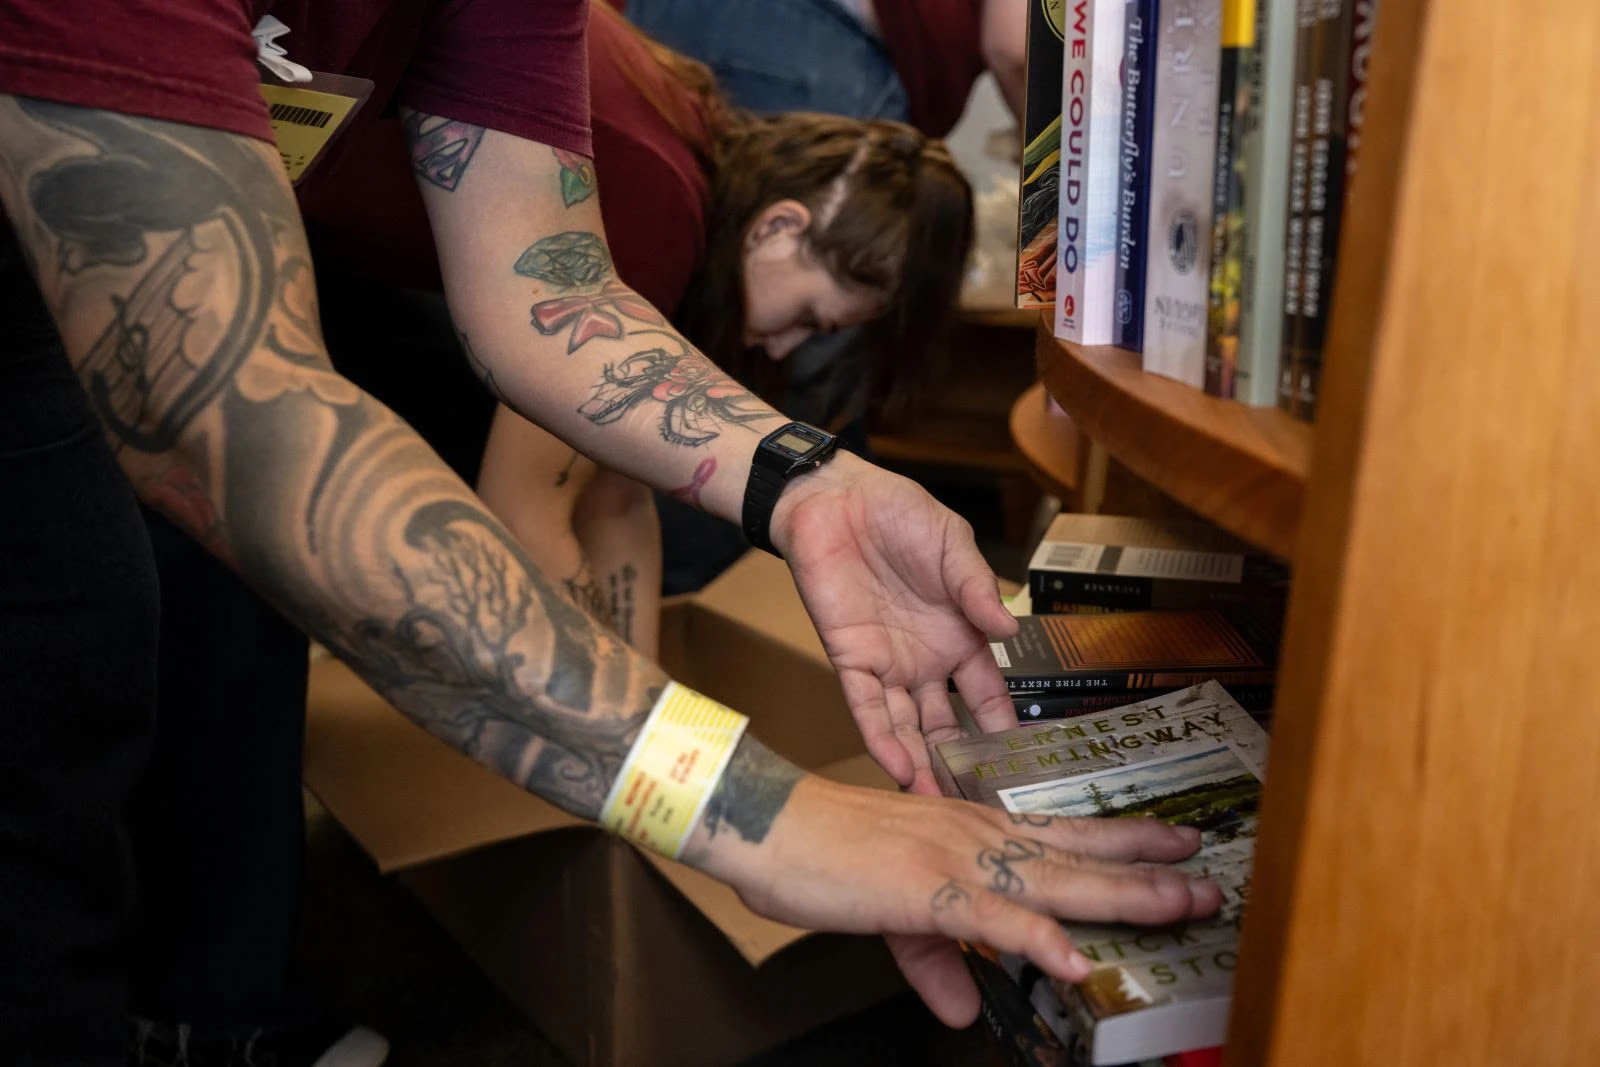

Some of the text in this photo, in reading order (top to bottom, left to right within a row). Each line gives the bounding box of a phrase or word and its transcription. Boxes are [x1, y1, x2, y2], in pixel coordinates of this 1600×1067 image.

[1064, 0, 1087, 274] WE COULD DO
[1119, 17, 1143, 270] The Butterfly's Burden
[1020, 680, 1050, 688] NEXT
[1086, 679, 1108, 687] THE
[974, 711, 1224, 780] HEMINGWAY
[1006, 704, 1166, 751] ERNEST
[1150, 951, 1239, 985] STO
